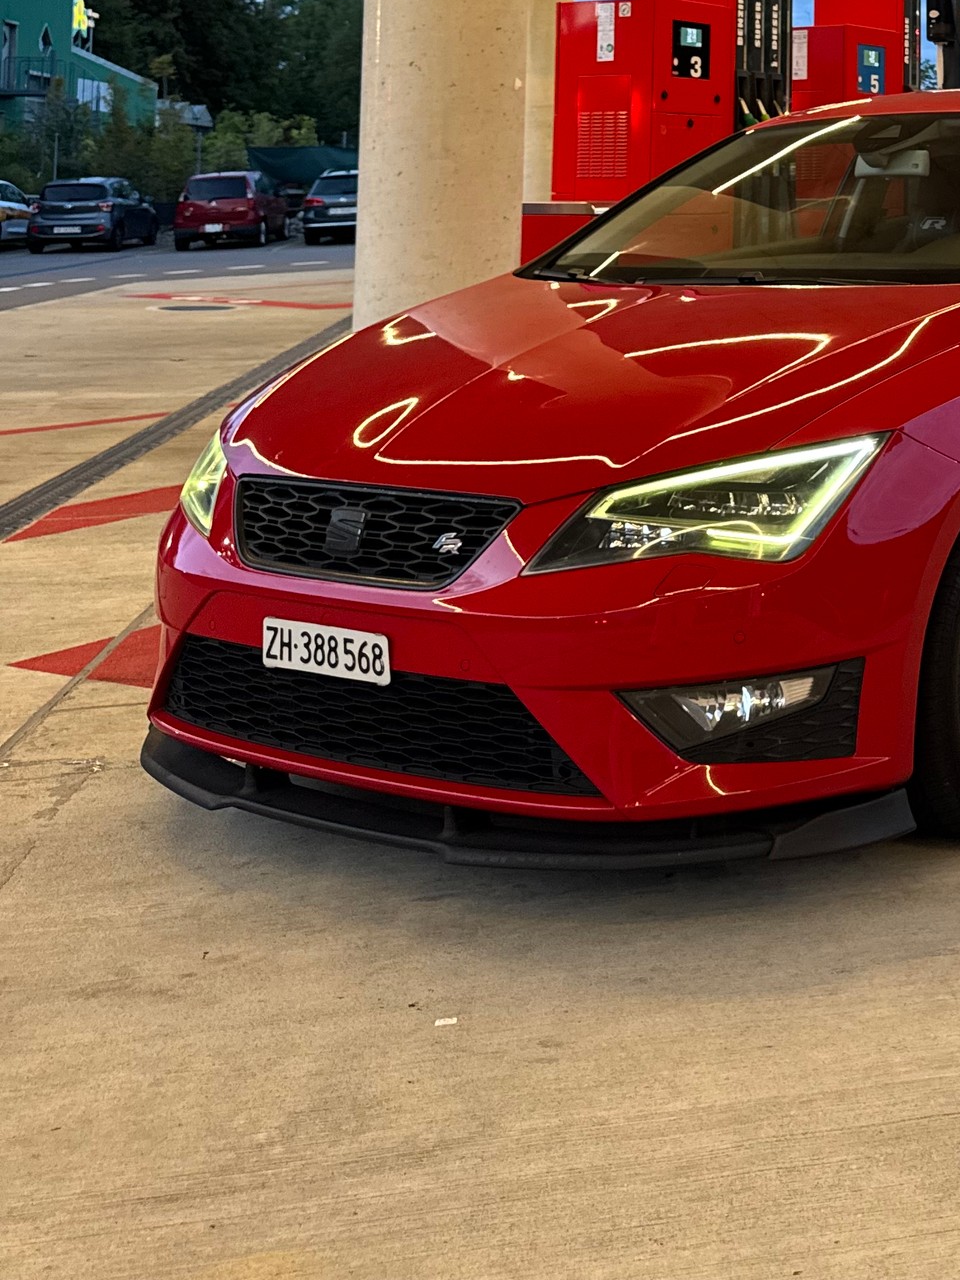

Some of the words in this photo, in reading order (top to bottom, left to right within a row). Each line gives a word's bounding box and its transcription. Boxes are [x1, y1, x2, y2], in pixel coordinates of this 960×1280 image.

[754, 1, 762, 48] SUPER
[771, 3, 779, 50] DIESEL
[690, 55, 702, 78] 3
[870, 74, 880, 94] 5
